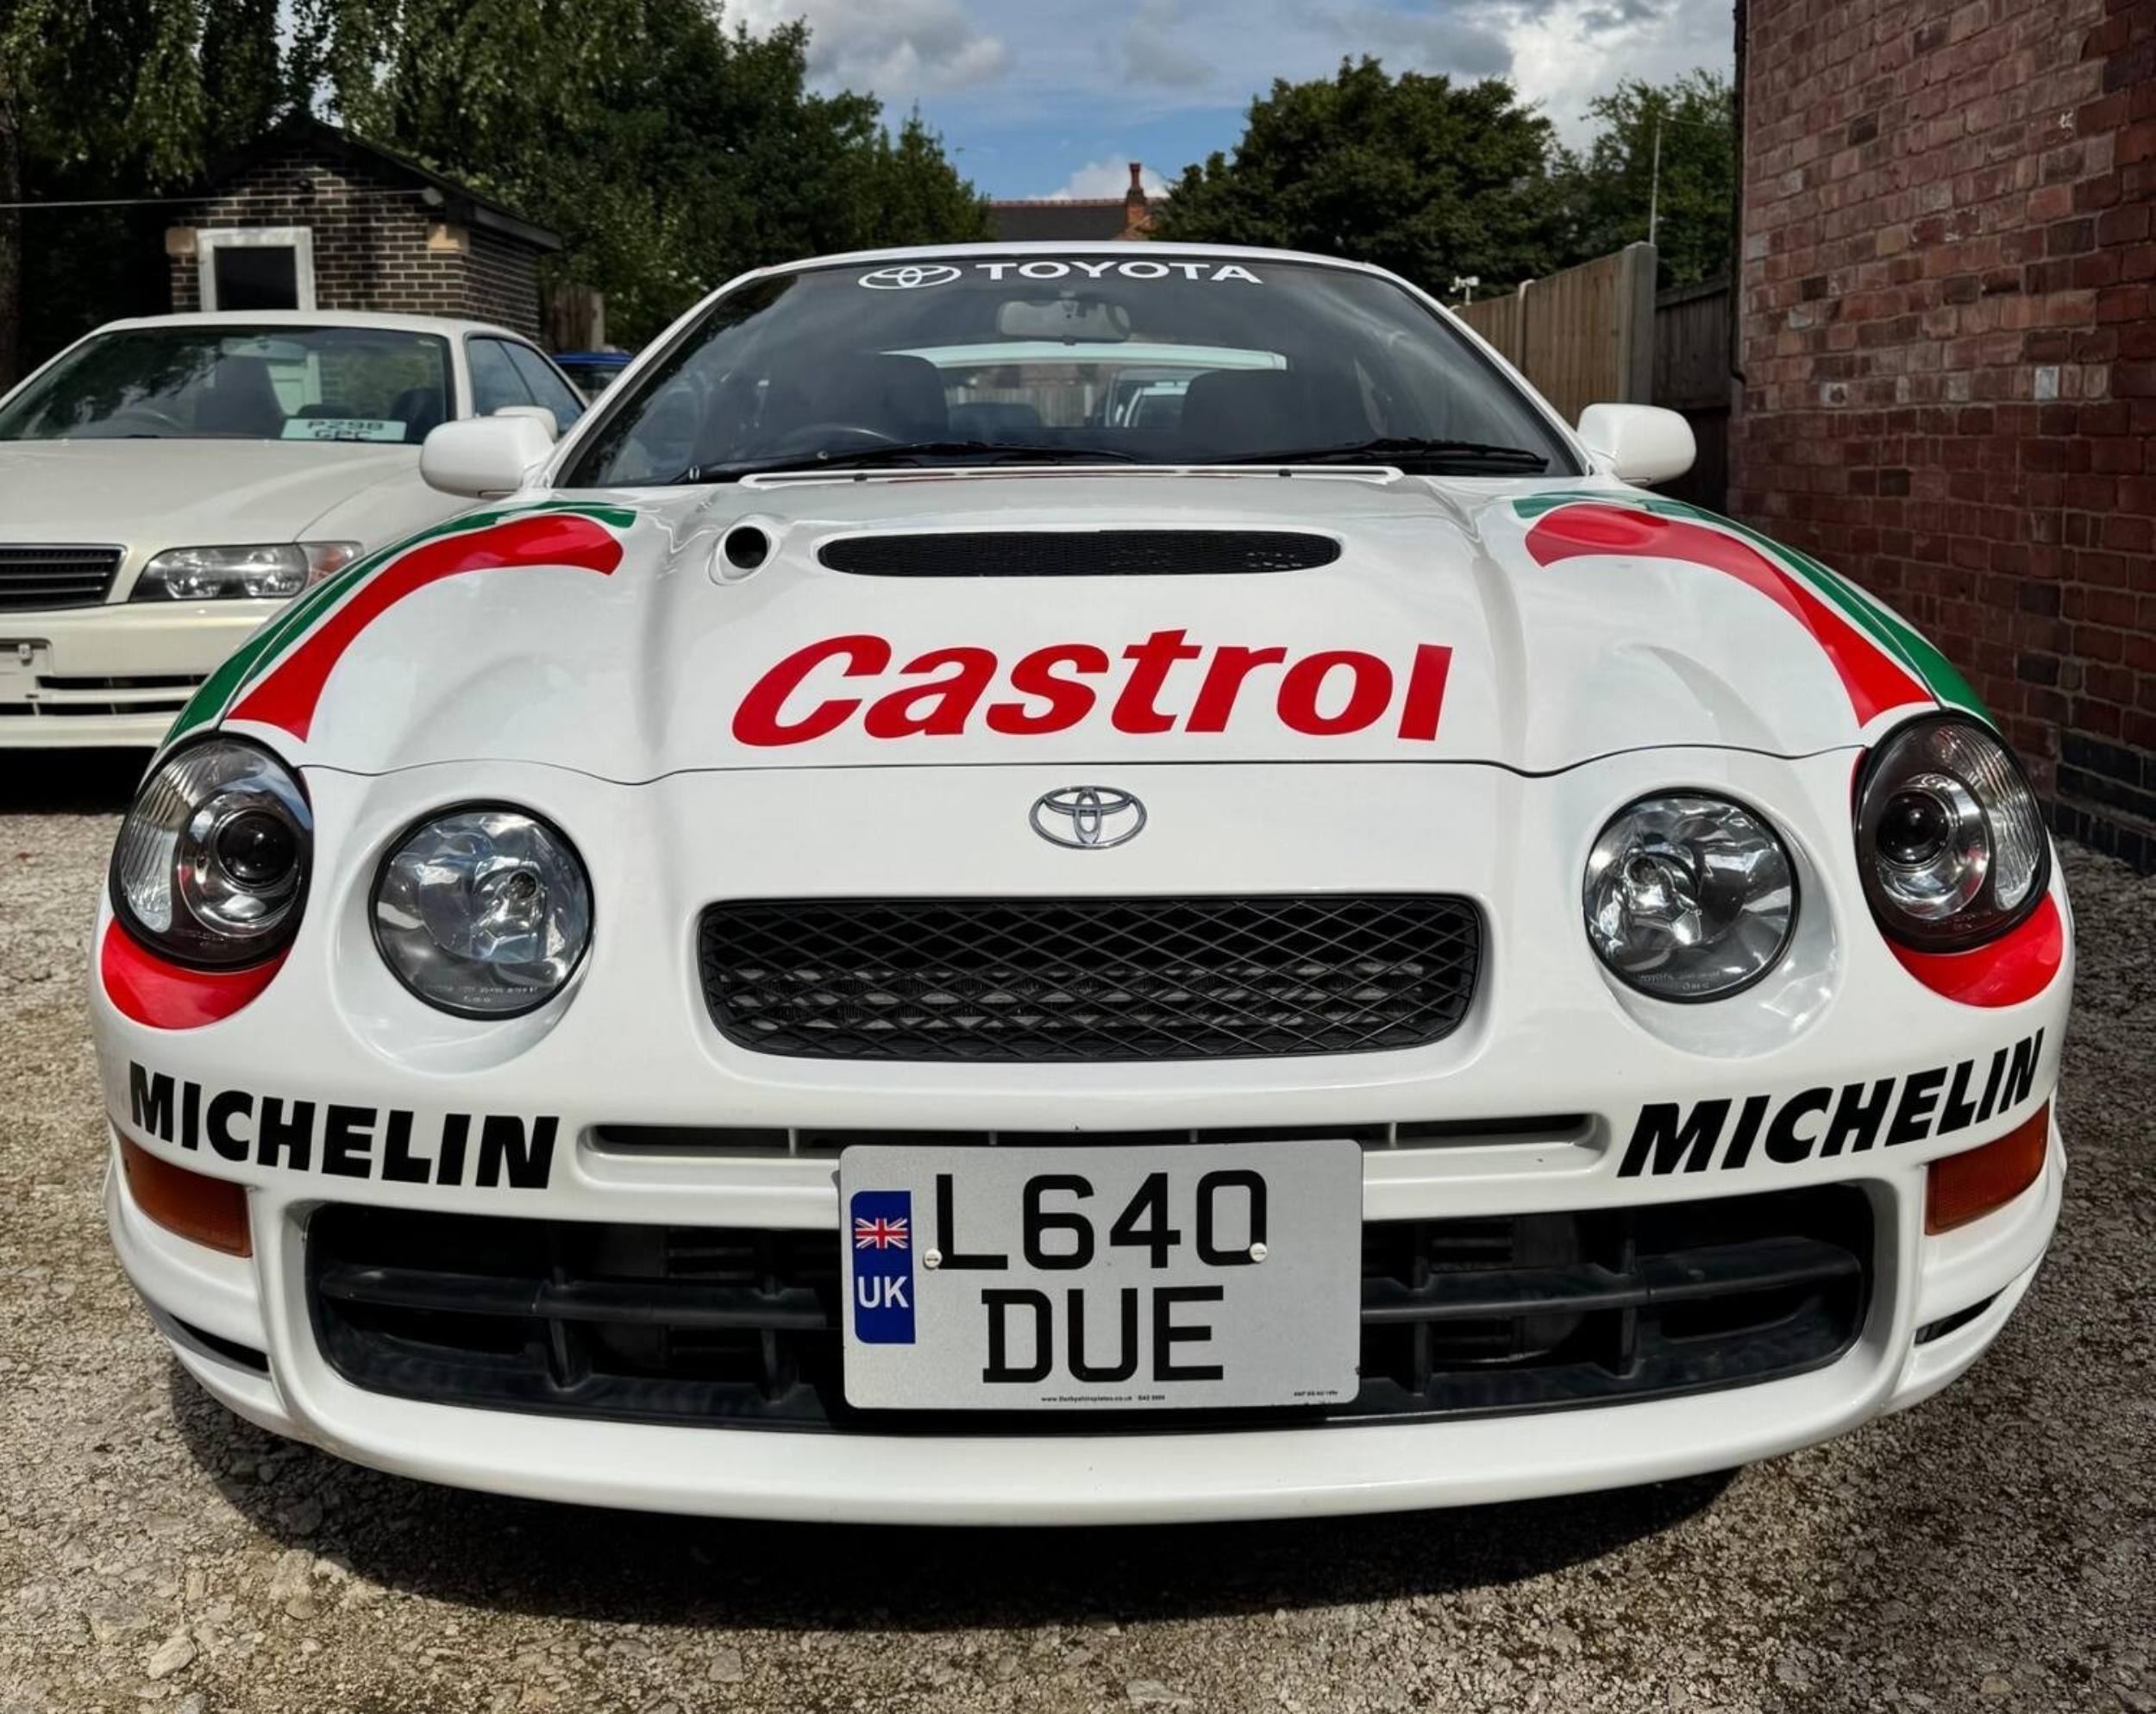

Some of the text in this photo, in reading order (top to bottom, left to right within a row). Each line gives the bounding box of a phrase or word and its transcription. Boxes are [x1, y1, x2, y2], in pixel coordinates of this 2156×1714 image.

[975, 261, 1263, 284] TOYOTA
[731, 629, 1452, 747] Castrol
[129, 1059, 560, 1190] MICHELIN
[1616, 1027, 2045, 1178] MICHELIN
[936, 1169, 1268, 1271] L640
[858, 1276, 909, 1309] UK
[981, 1284, 1224, 1383] DUE
